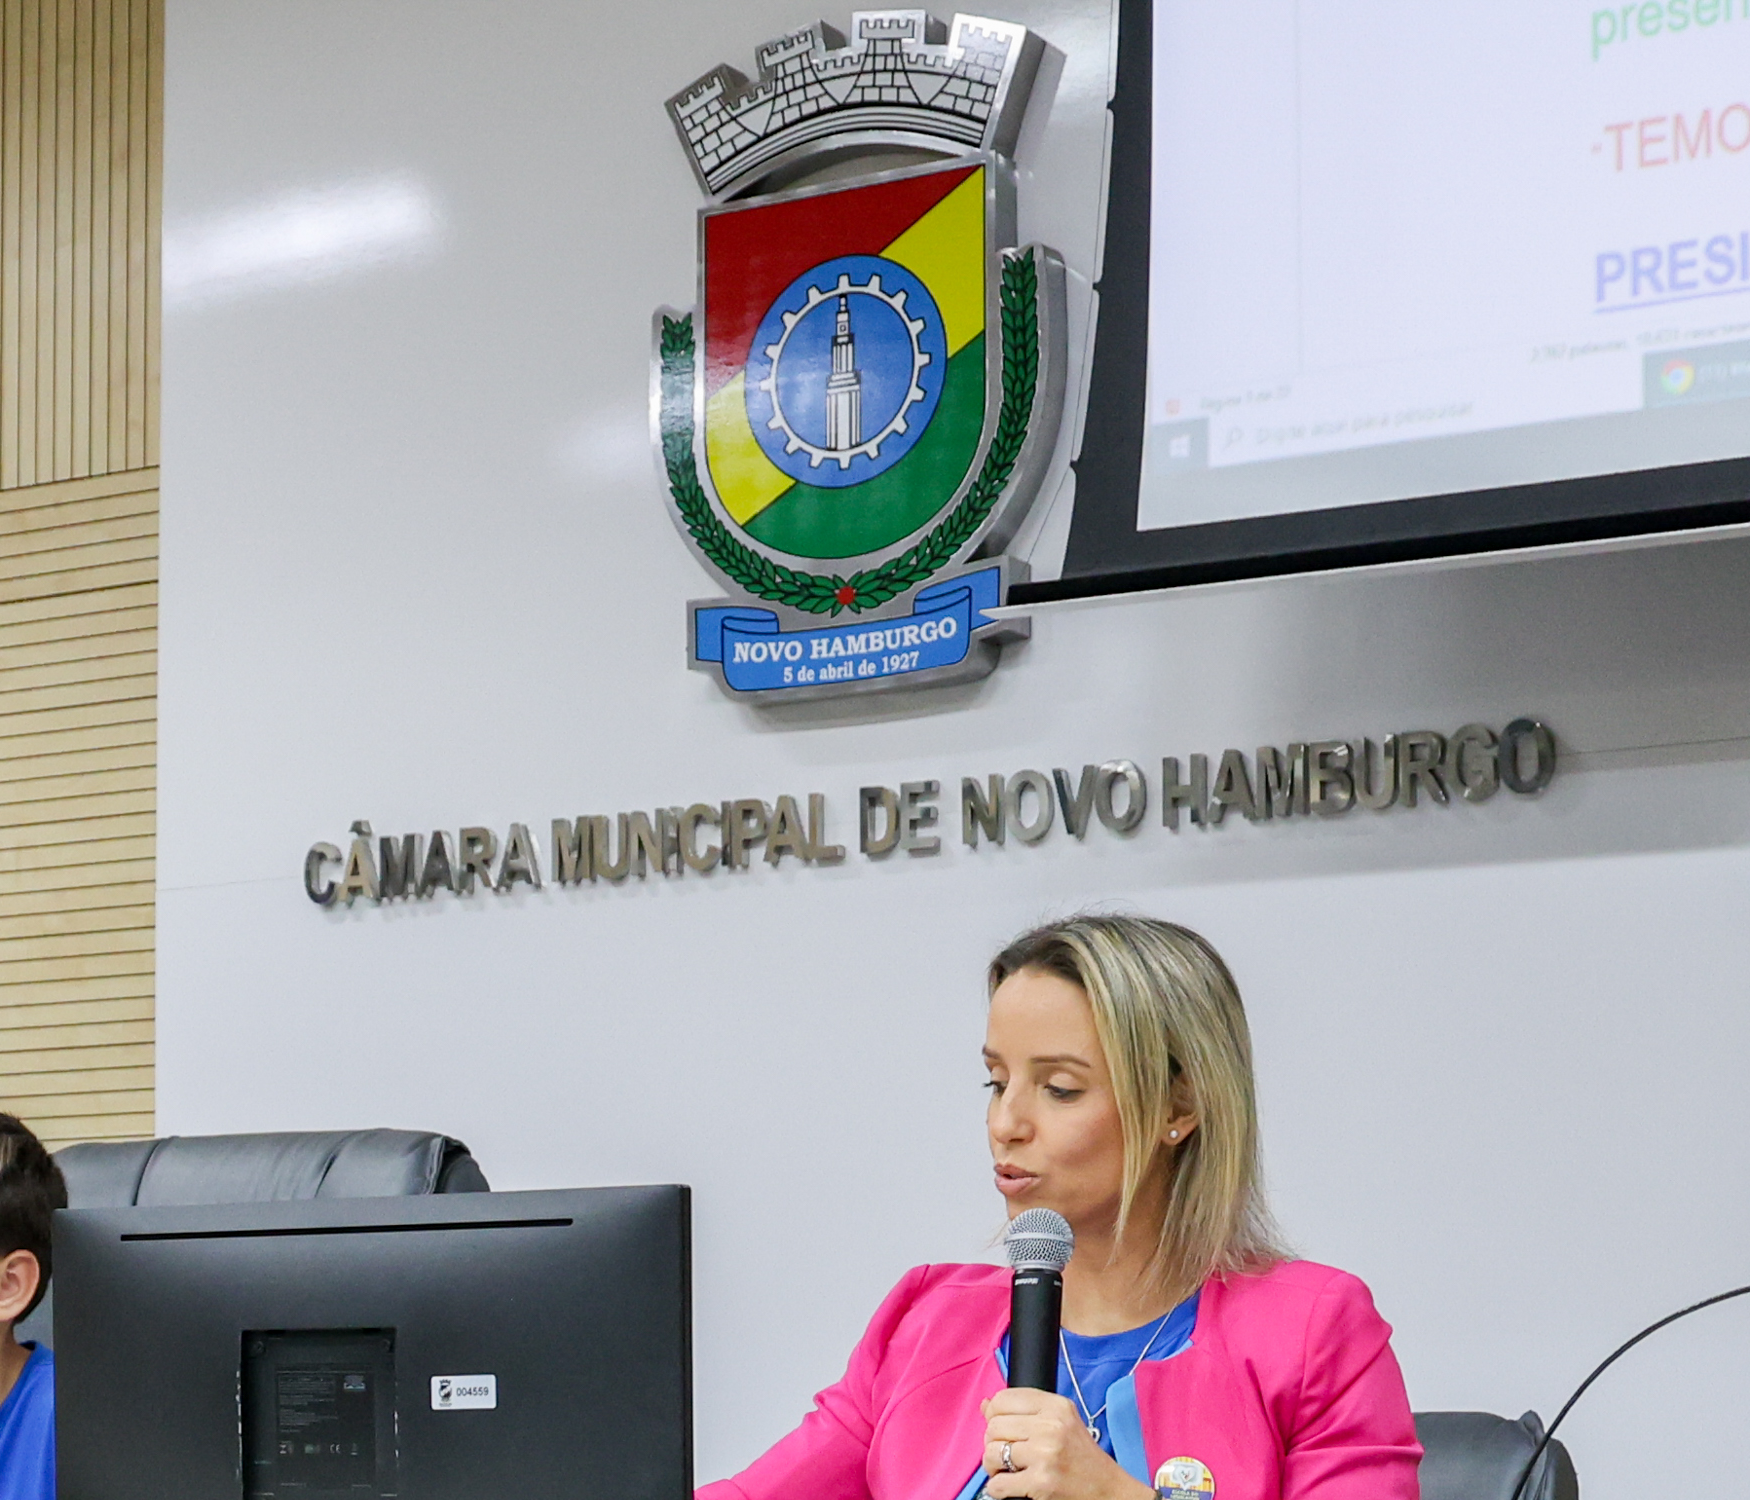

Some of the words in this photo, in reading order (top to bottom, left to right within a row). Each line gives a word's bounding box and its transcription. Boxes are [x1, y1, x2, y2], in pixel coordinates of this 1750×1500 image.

[732, 640, 803, 663] NOVO
[809, 616, 958, 660] HAMBURGO
[783, 666, 794, 683] 5
[797, 664, 815, 682] de
[819, 660, 854, 681] abril
[858, 658, 877, 676] de
[881, 650, 920, 673] 1927
[303, 819, 548, 905] CÂMARA
[551, 792, 847, 886] MUNICIPAL
[859, 778, 941, 857] DE
[960, 757, 1149, 848] NOVO
[1161, 718, 1557, 831] HAMBURGO
[456, 1386, 489, 1397] 004559
